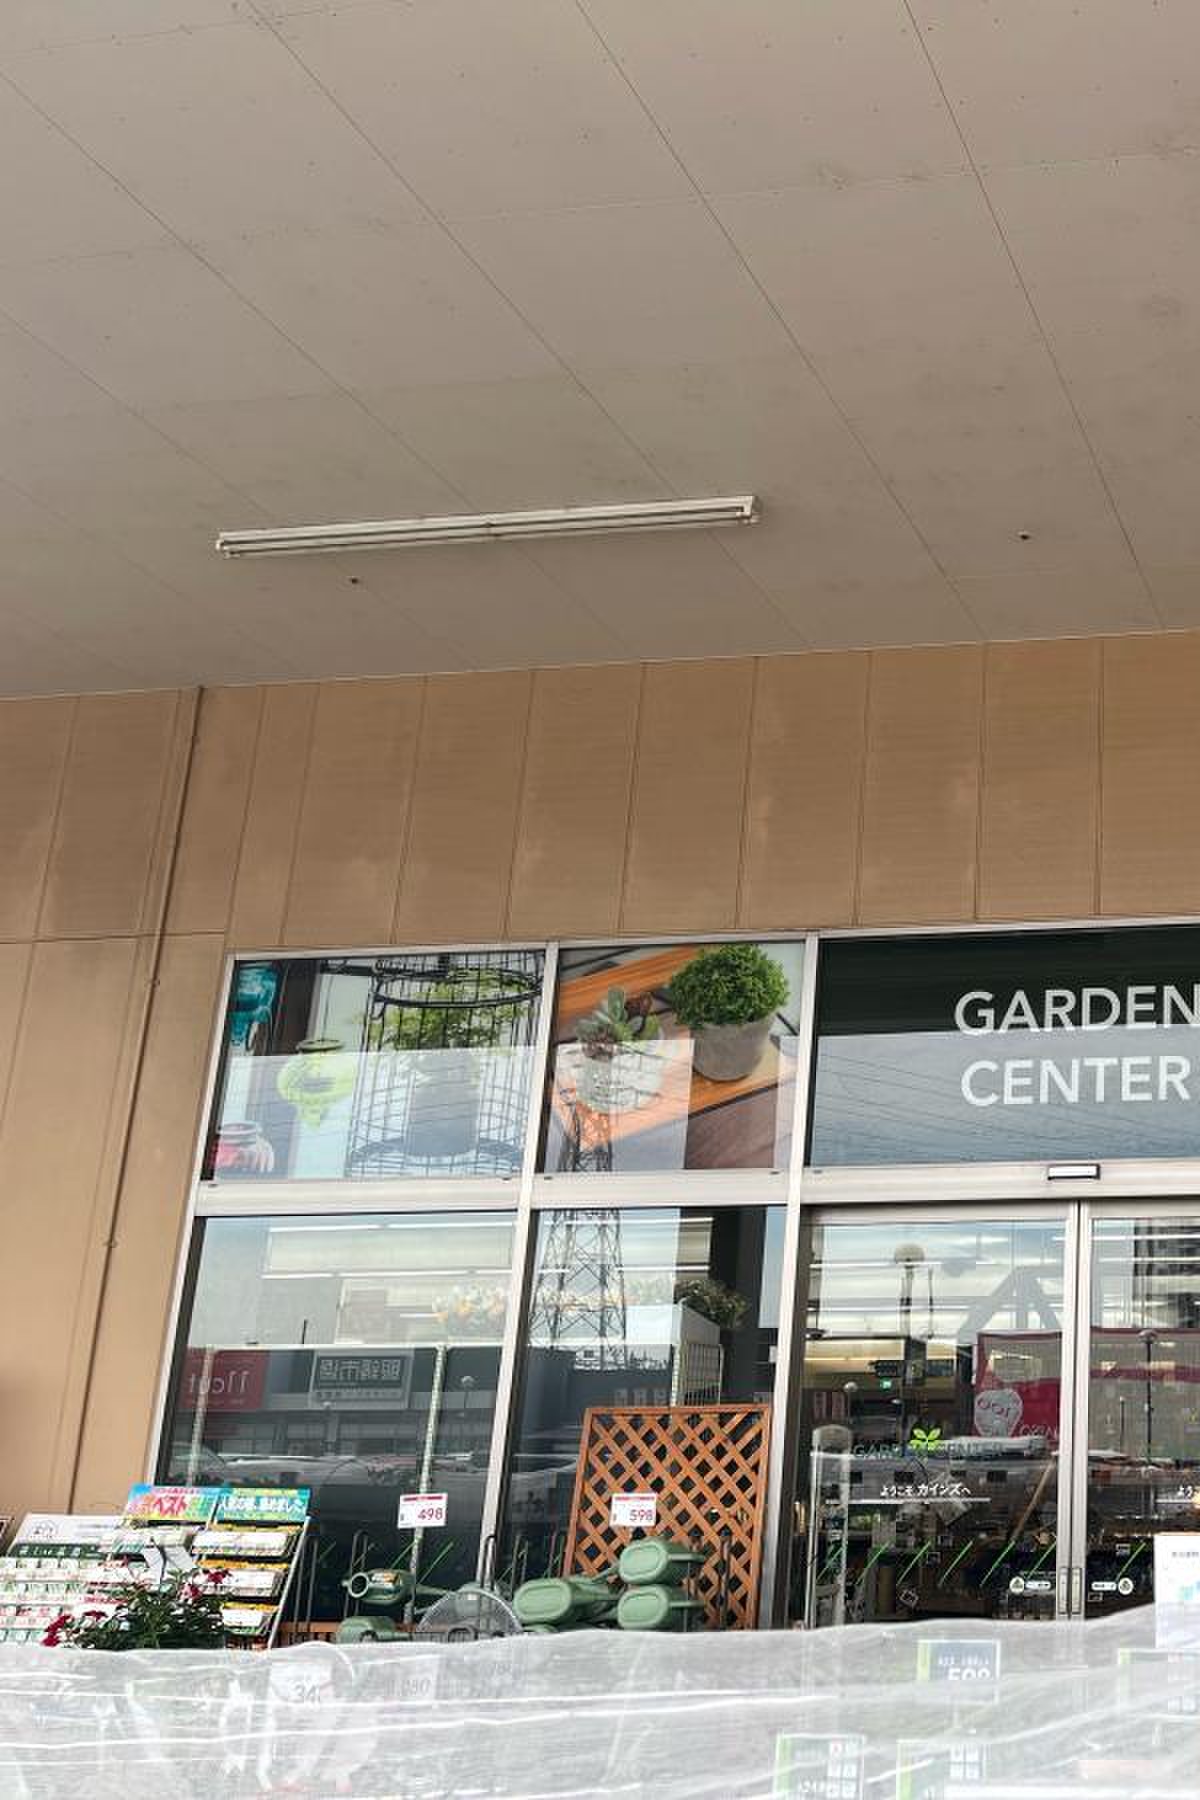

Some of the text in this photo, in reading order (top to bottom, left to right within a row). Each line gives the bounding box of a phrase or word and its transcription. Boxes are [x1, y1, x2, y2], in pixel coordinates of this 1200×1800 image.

[960, 1055, 1191, 1107] CENTER
[880, 1482, 972, 1497] ようこそ カインズへ
[417, 1507, 443, 1520] 498
[631, 1511, 657, 1524] 598
